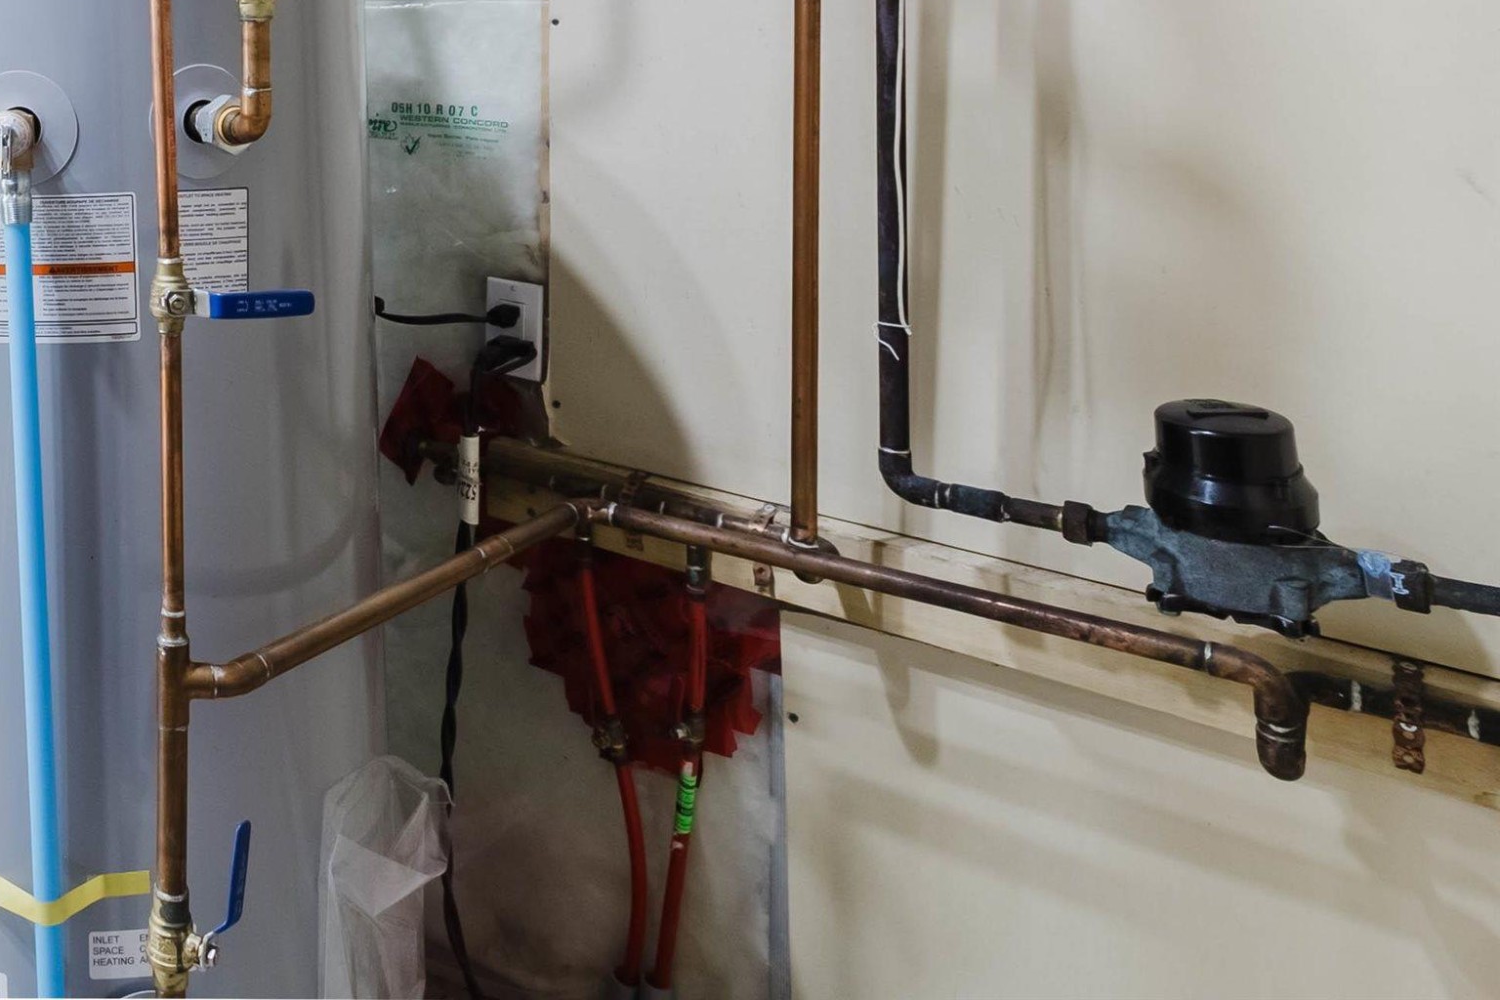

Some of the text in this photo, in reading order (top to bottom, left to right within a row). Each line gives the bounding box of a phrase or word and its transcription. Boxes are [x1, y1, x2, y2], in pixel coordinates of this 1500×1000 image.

[400, 115, 509, 129] WESTERN CONCORD
[92, 935, 120, 945] INLET
[92, 946, 125, 956] SPACE
[93, 956, 135, 967] HEATING
